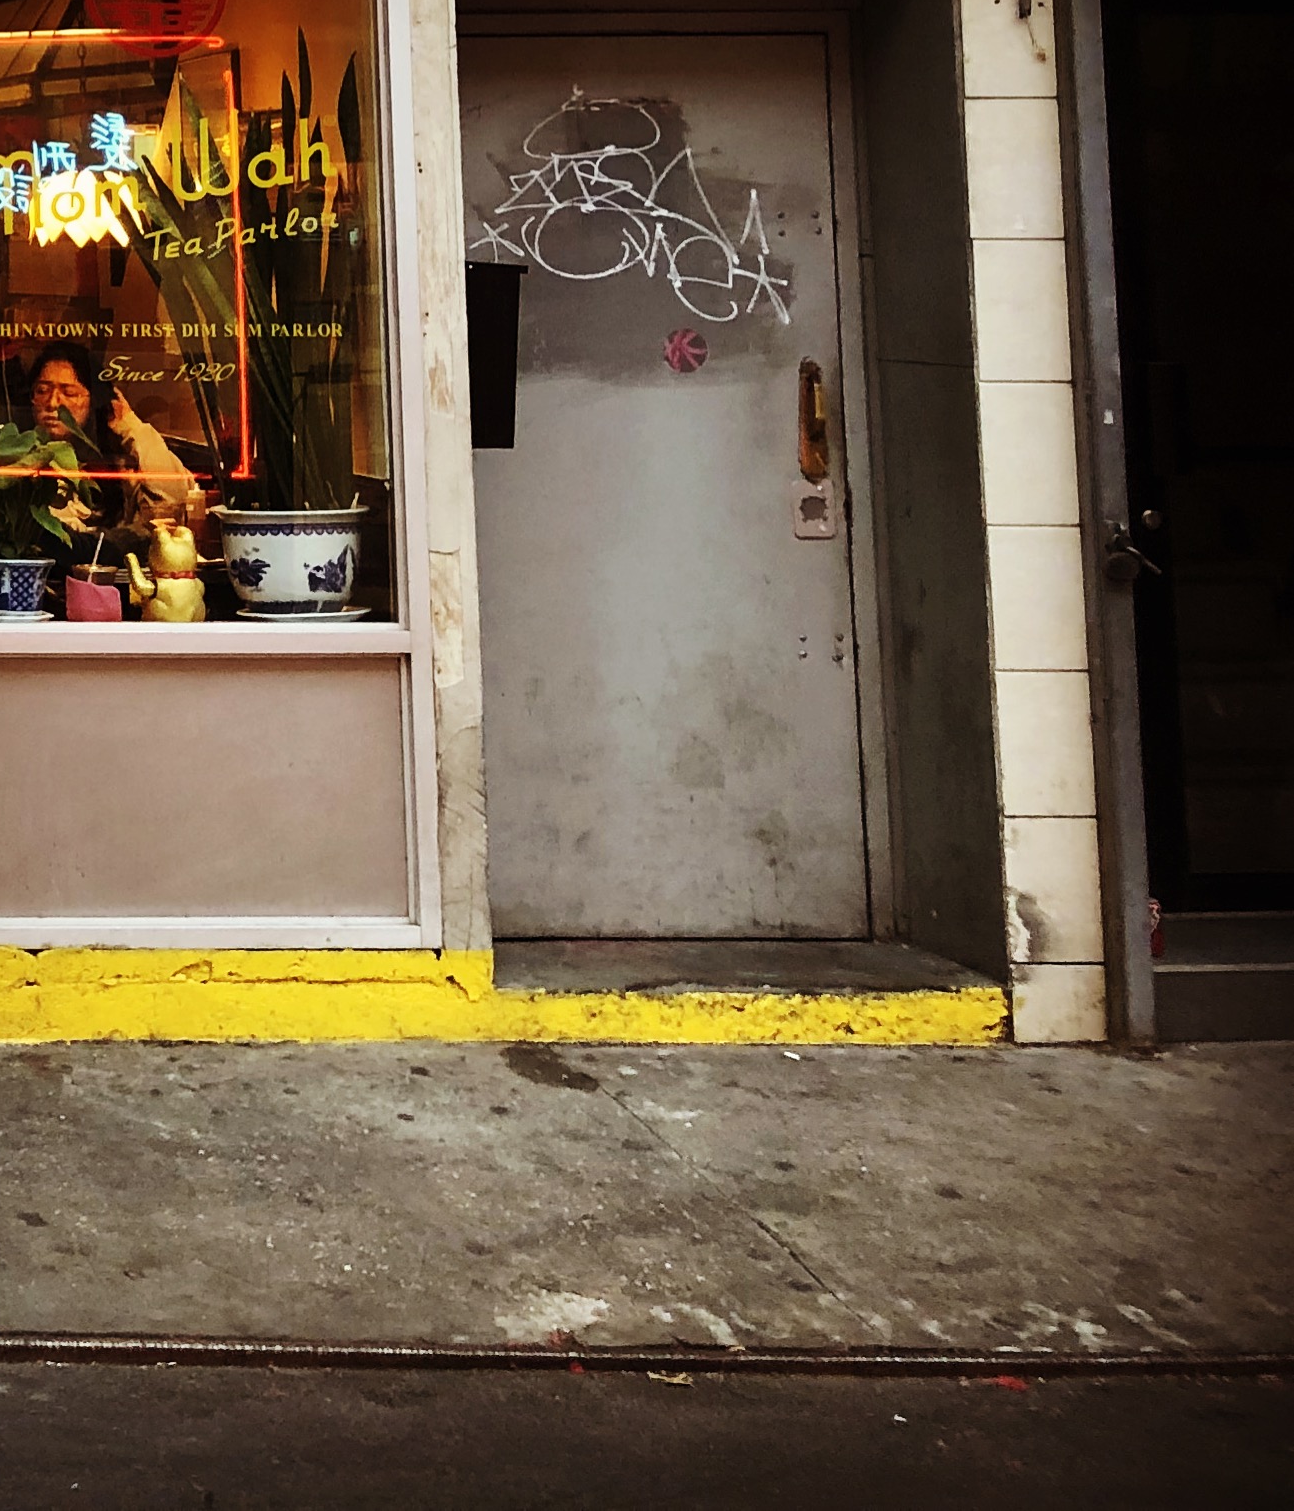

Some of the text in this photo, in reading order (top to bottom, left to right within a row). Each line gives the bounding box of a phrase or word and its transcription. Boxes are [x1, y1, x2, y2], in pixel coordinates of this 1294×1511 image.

[171, 117, 338, 201] Wah
[144, 207, 339, 261] Tea Parlor
[121, 322, 175, 338] FIRST
[181, 322, 217, 338] DIM
[271, 322, 343, 338] PARLOR
[98, 355, 165, 383] Since
